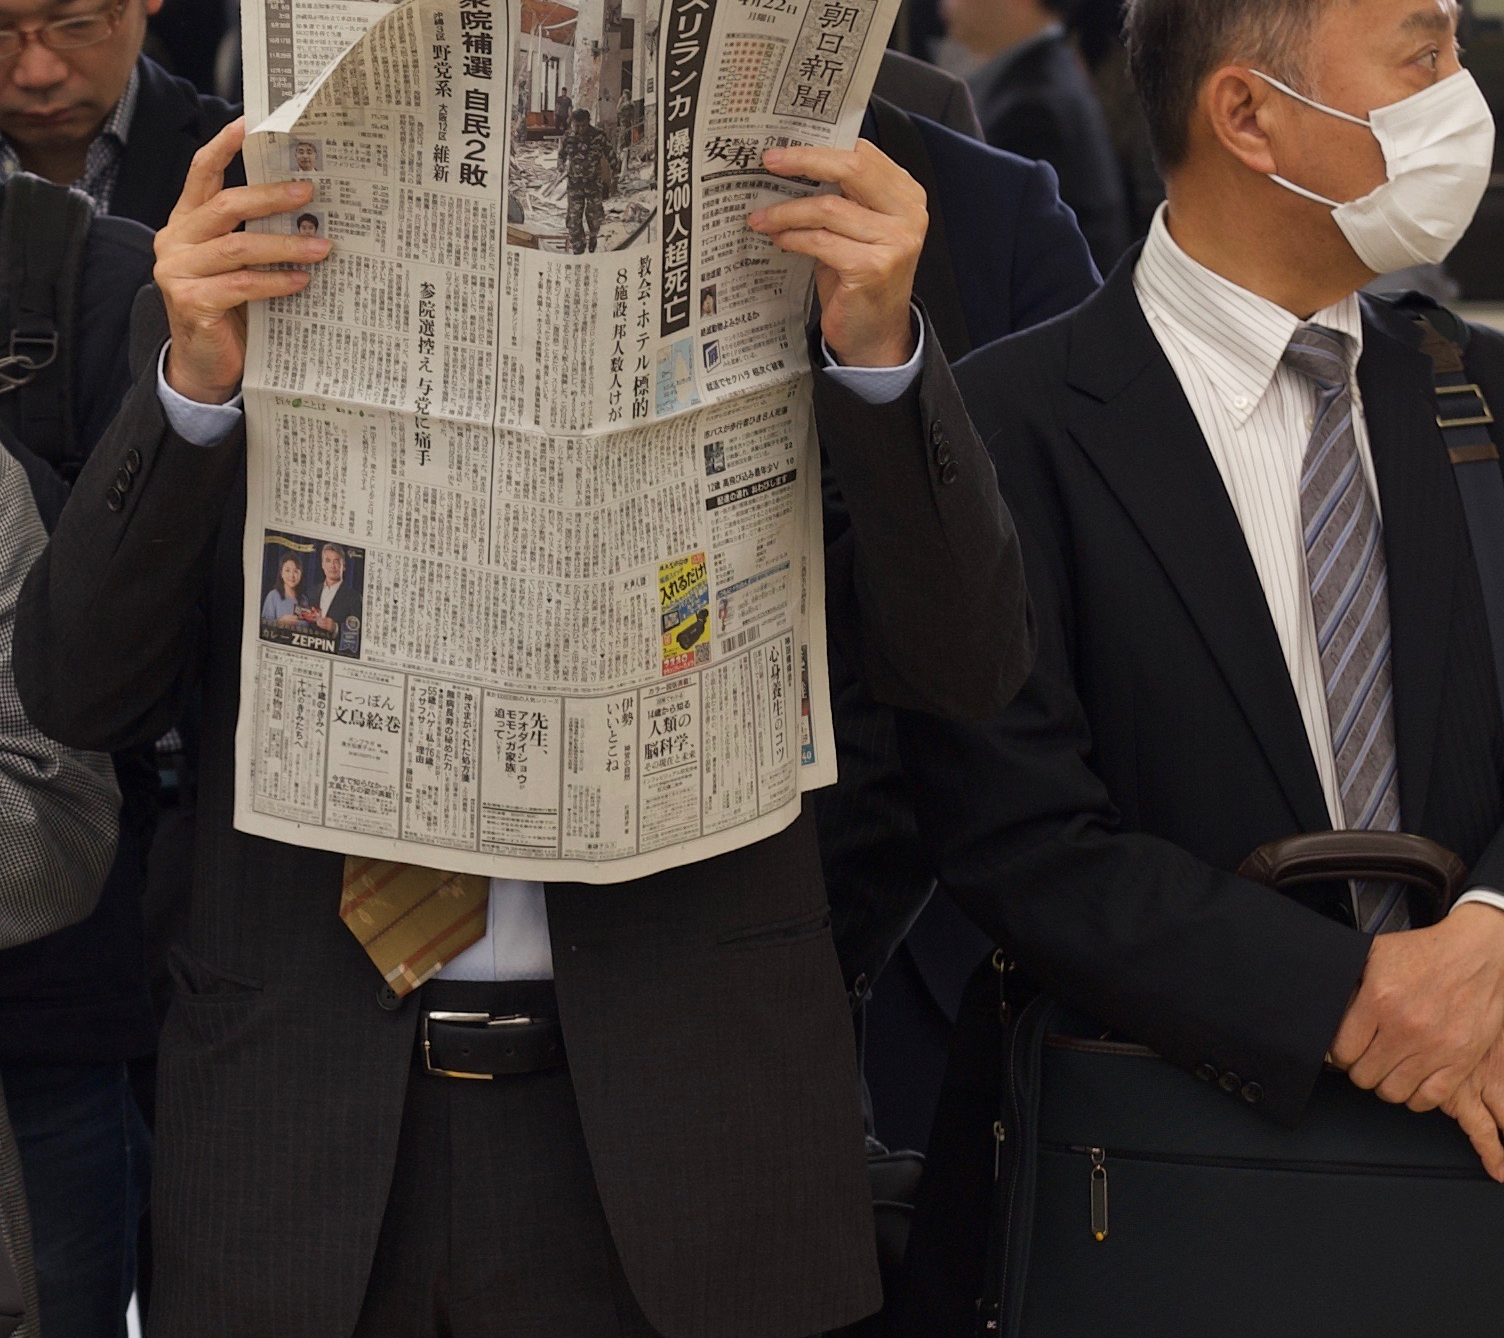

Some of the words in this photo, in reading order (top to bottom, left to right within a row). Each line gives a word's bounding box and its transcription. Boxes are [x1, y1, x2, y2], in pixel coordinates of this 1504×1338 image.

[747, 12, 777, 24] 月曜日
[432, 44, 452, 98] 野党系
[791, 1, 861, 115] 朝日新聞
[459, 88, 491, 189] 自民2敗
[704, 137, 757, 169] 安寿
[432, 144, 449, 183] 維新
[663, 128, 691, 324] 爆発200人超死亡
[417, 281, 436, 374] 参院選控え
[632, 255, 652, 419] 教会・ホテル標的
[414, 376, 434, 467] 与党に痛手
[291, 633, 336, 653] ZEPPIN
[332, 705, 401, 734] 文鳥絵巻
[340, 689, 395, 711] にっぽん
[621, 697, 634, 728] 伊勢
[648, 713, 692, 739] 人類の
